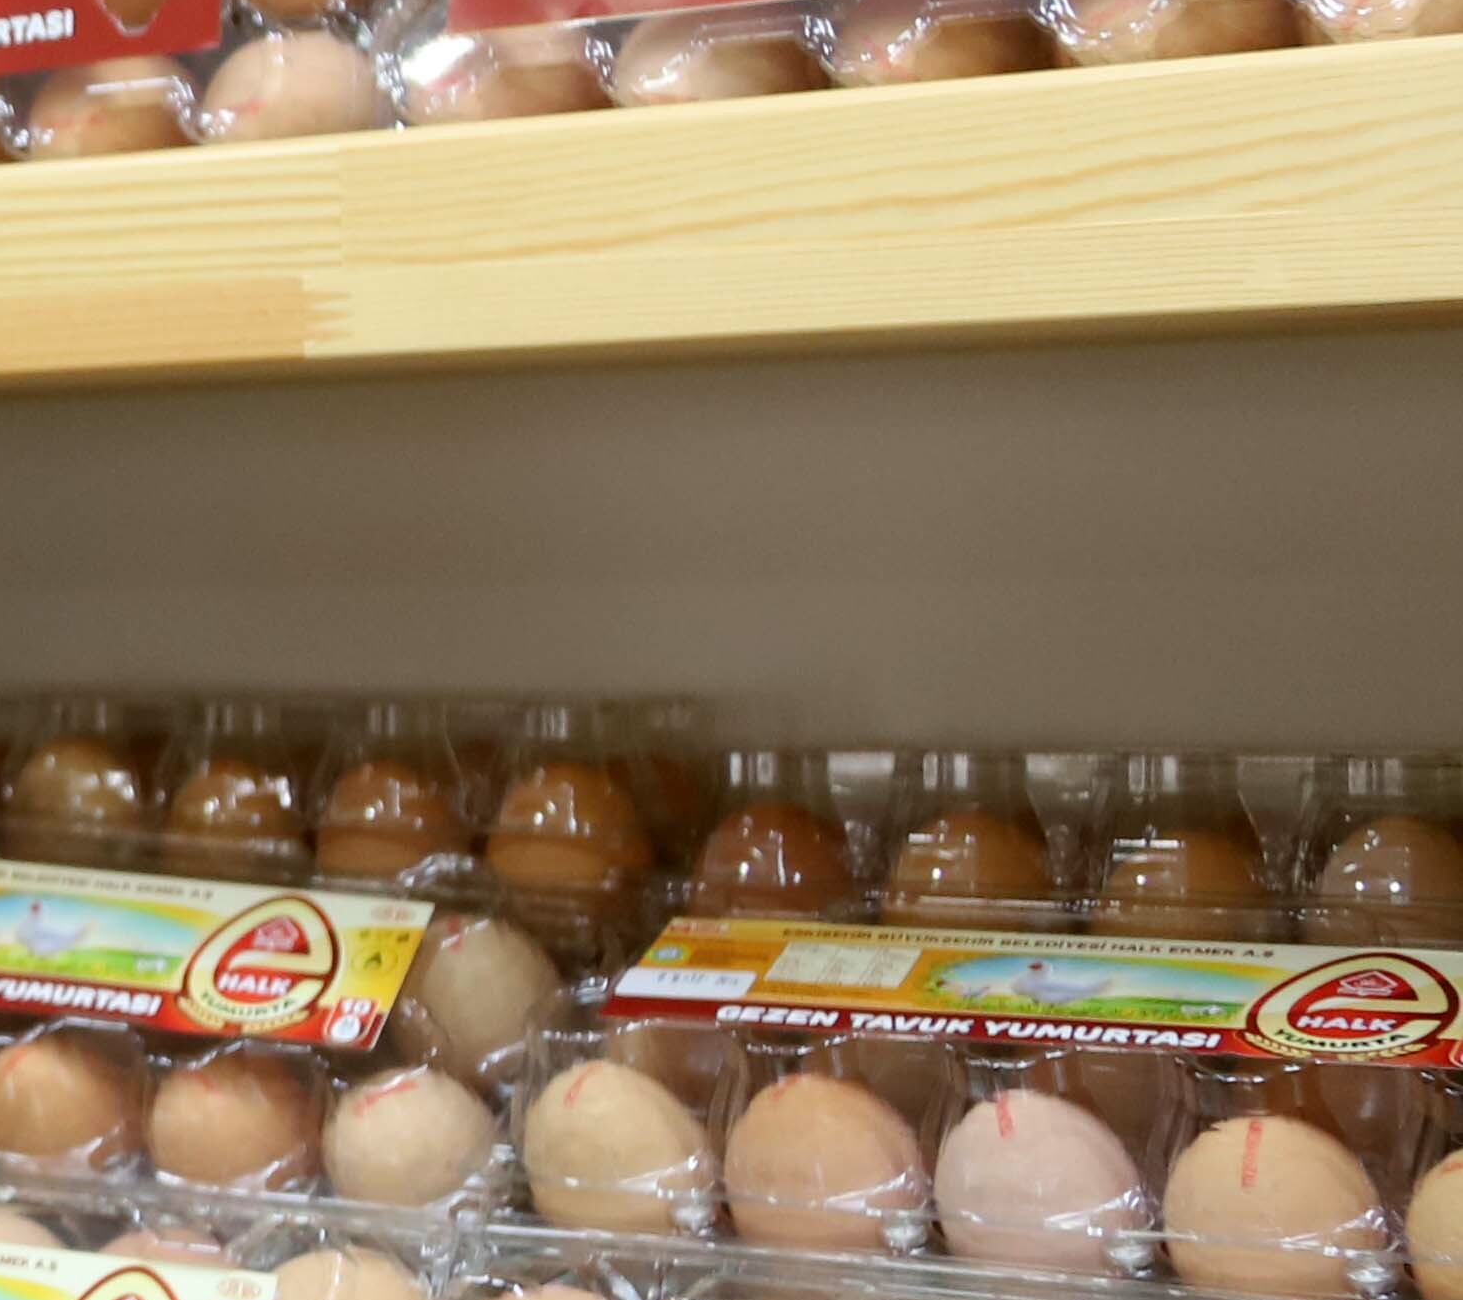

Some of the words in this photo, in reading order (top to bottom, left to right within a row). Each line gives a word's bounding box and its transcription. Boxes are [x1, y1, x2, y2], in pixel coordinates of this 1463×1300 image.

[1111, 942, 1162, 954] HALK
[219, 971, 290, 996] HALK
[716, 1005, 839, 1027] GEZEN
[849, 1012, 974, 1034] TAVUK
[983, 1020, 1222, 1047] YUMURTASI
[1295, 1015, 1397, 1032] HALK
[1274, 1027, 1410, 1049] YUMURTA
